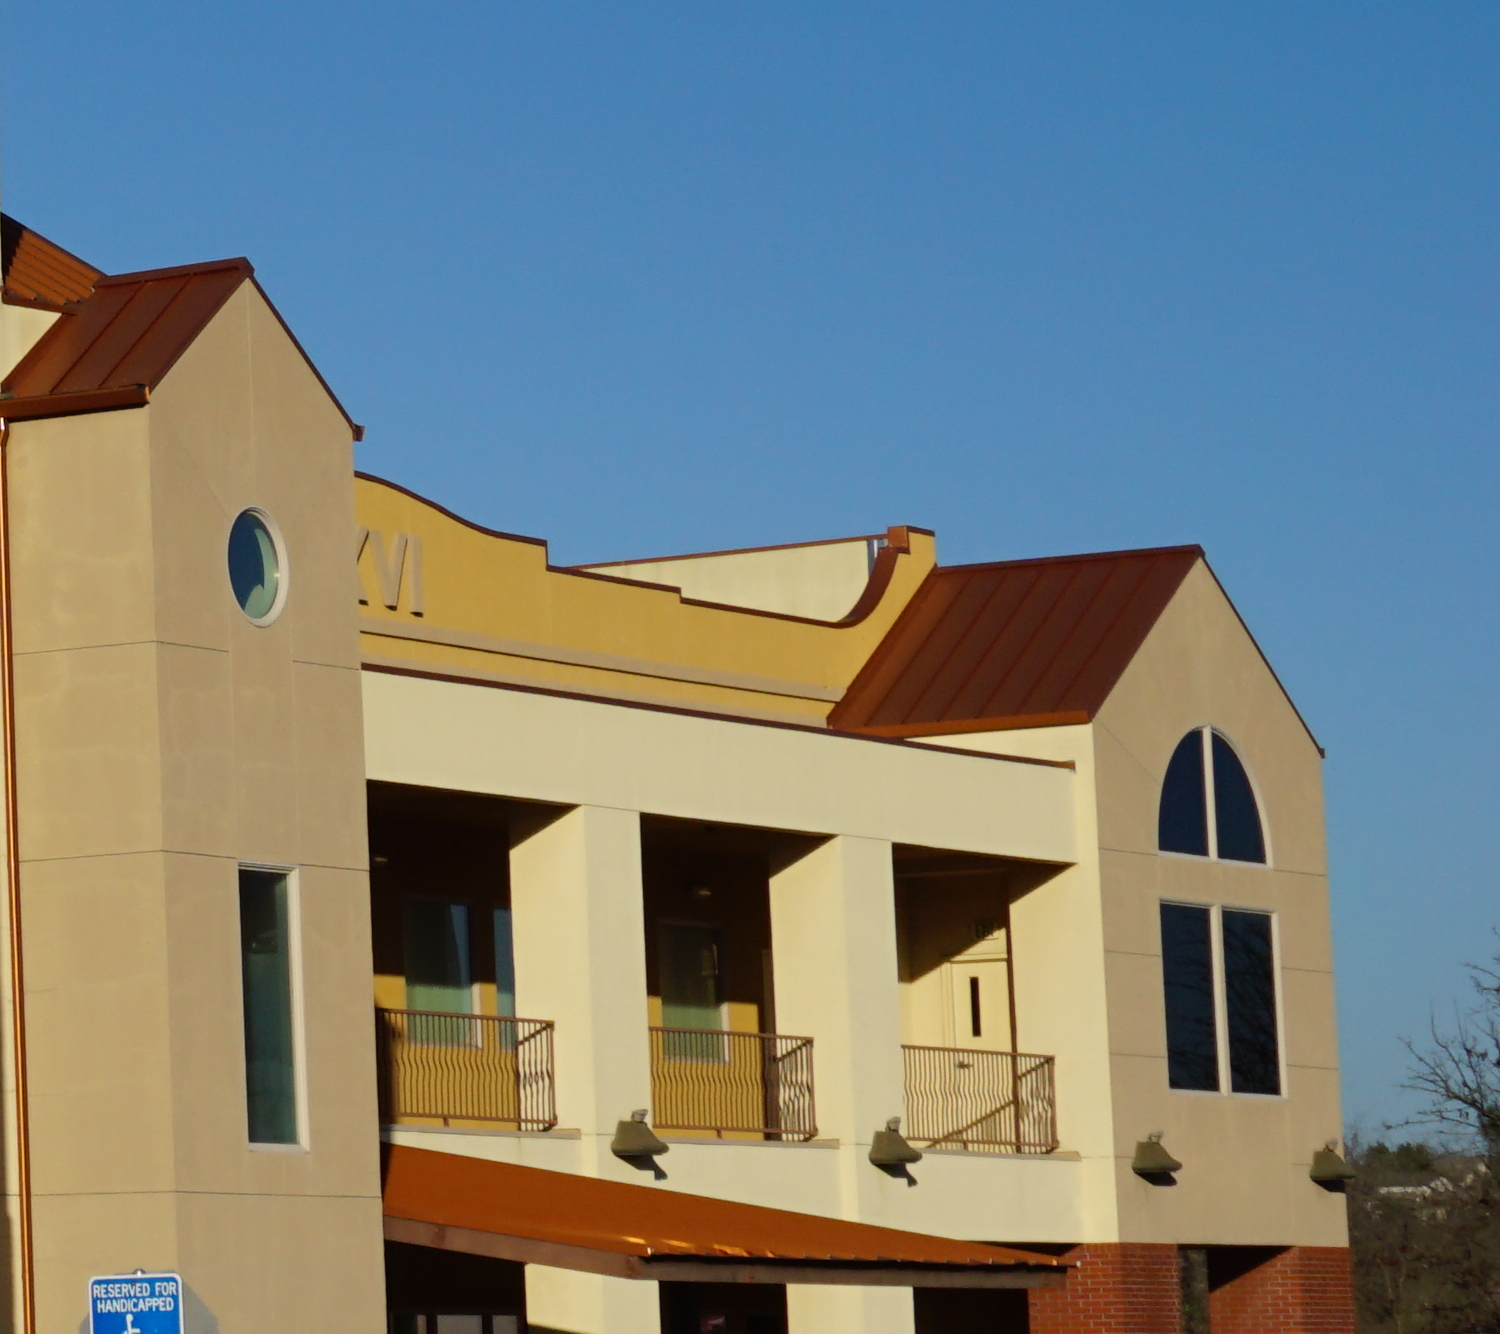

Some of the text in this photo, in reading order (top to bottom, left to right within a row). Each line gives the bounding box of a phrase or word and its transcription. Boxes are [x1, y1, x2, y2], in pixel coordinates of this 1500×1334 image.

[93, 1281, 177, 1298] RESERVED FOR
[97, 1297, 175, 1314] HANDICAPPED
